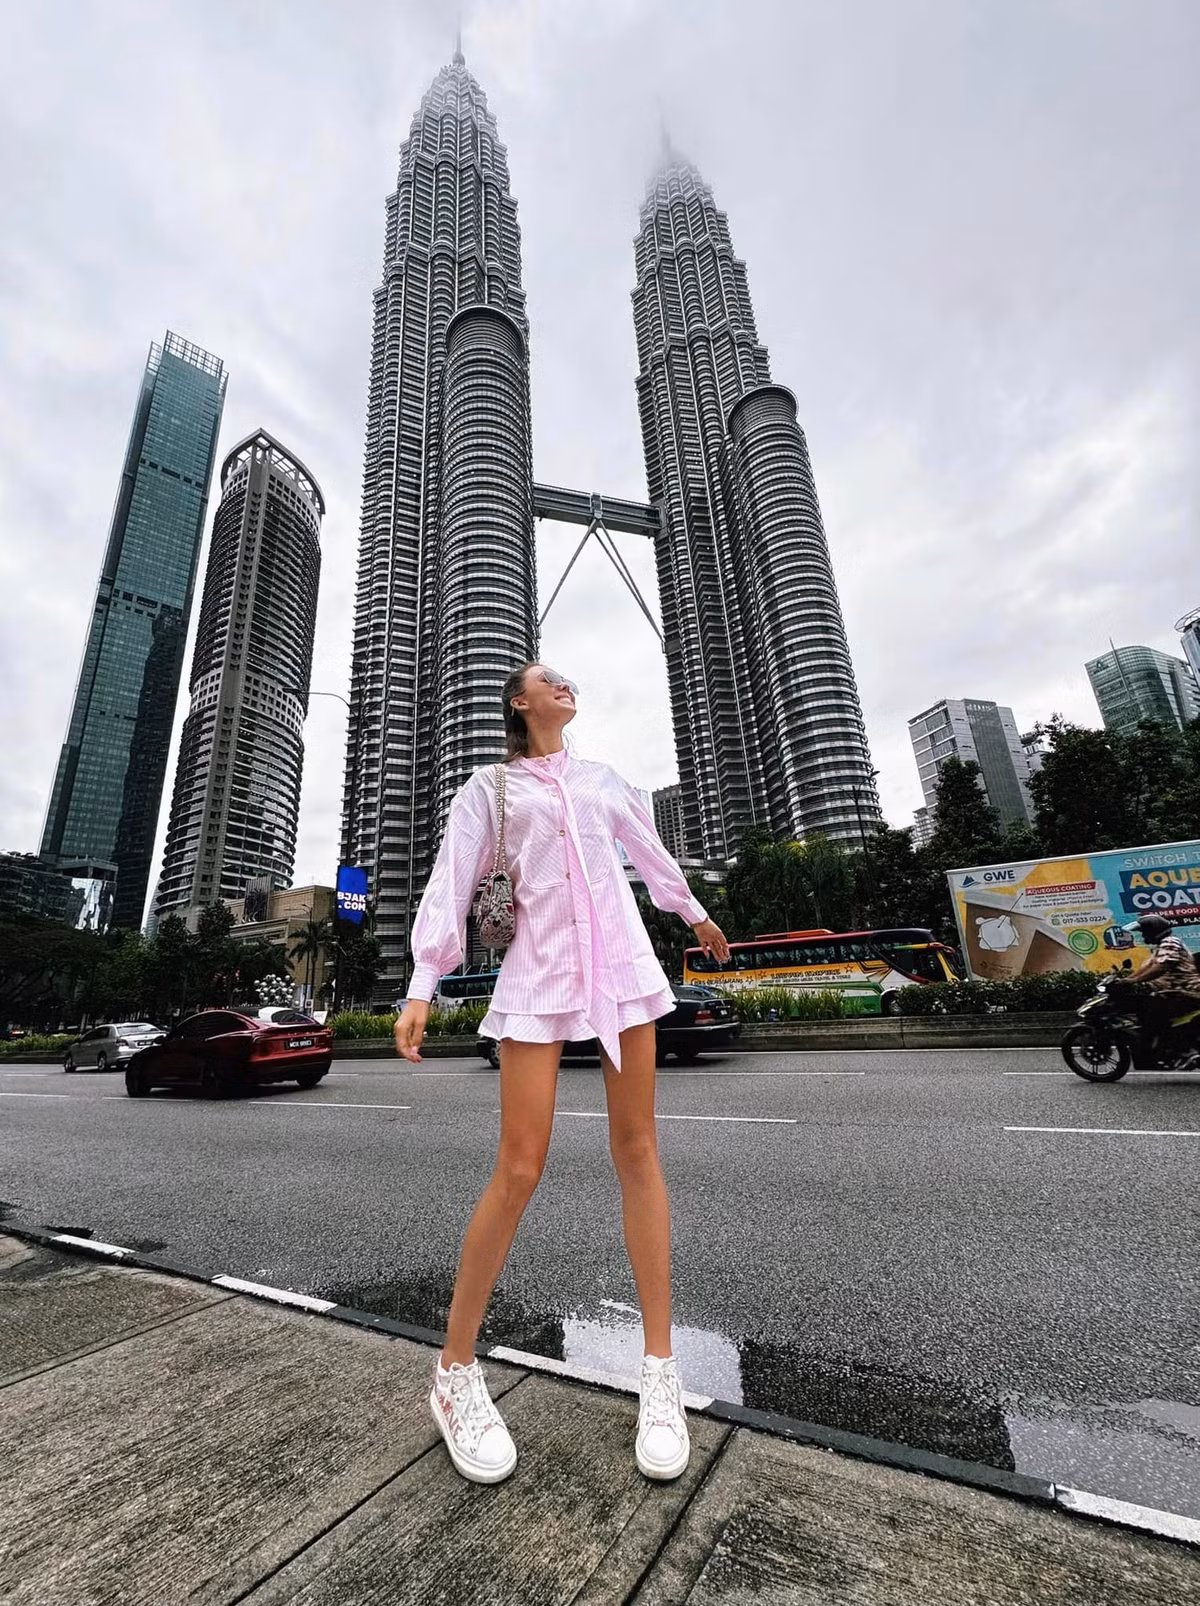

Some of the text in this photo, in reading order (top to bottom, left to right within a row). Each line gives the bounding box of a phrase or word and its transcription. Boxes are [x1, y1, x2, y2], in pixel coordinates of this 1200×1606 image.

[1123, 852, 1187, 868] SWITCH
[983, 870, 1015, 882] GWE
[1129, 867, 1200, 889] AQUE
[1027, 883, 1093, 895] AQUEOUS COATING
[337, 891, 366, 902] BJAK
[1175, 907, 1199, 915] FOOD
